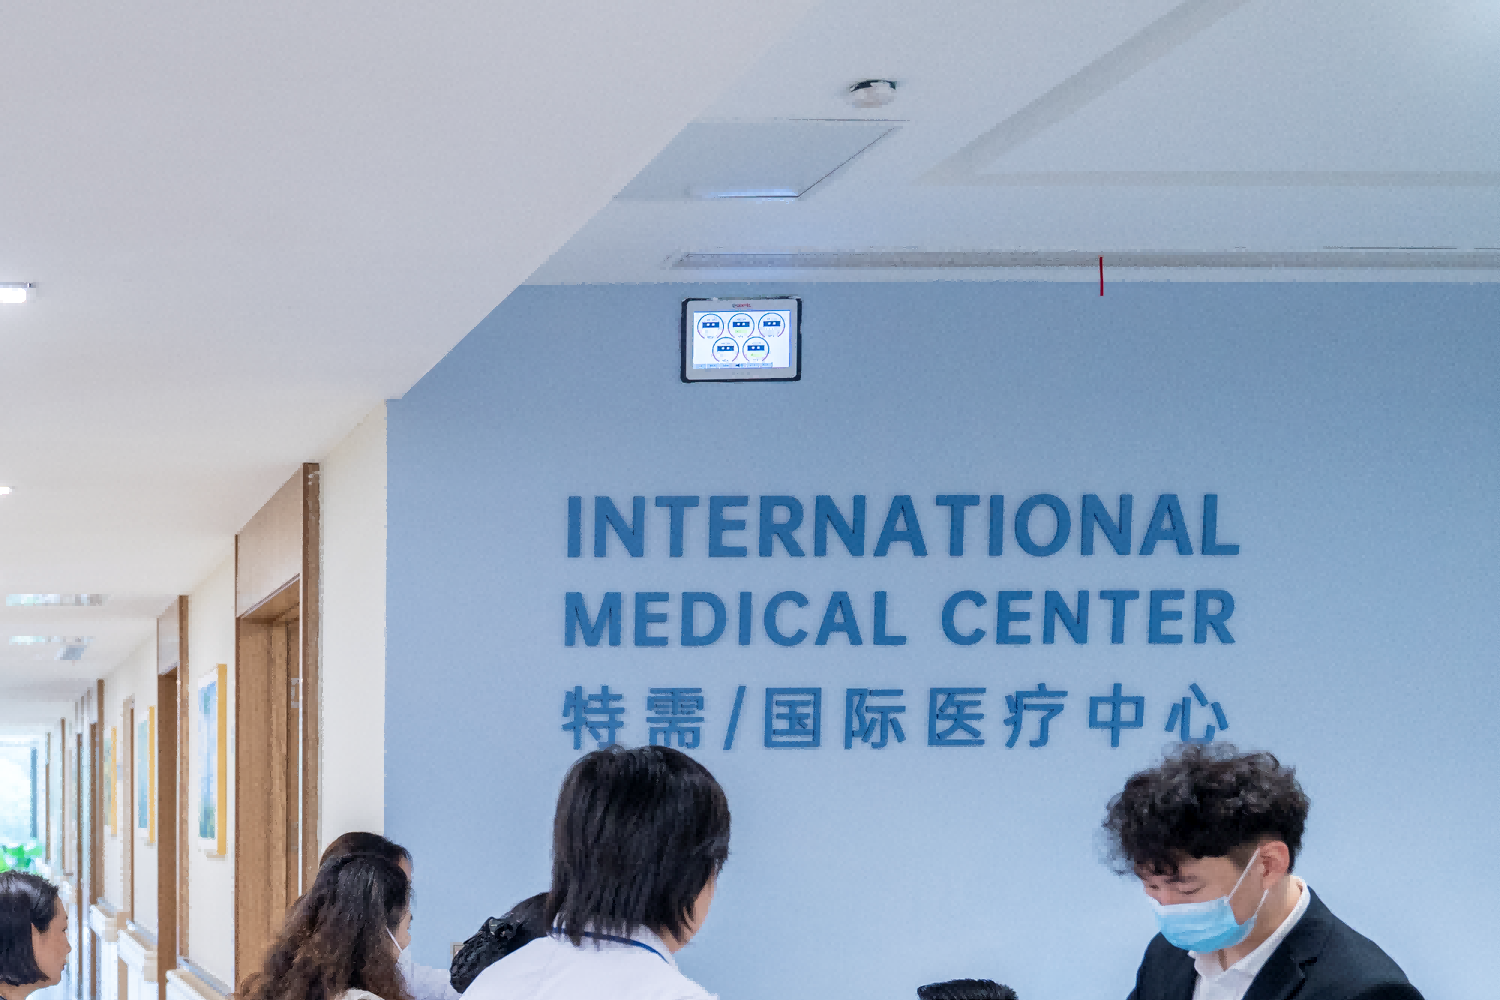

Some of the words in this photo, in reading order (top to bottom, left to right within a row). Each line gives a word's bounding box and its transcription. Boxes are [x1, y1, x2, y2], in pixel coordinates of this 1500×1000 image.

[565, 493, 1241, 559] INTERNATIONAL
[564, 590, 908, 649] MEDICAL
[941, 588, 1237, 646] CENTER
[561, 682, 1230, 750] 特需/国际医疗中心
